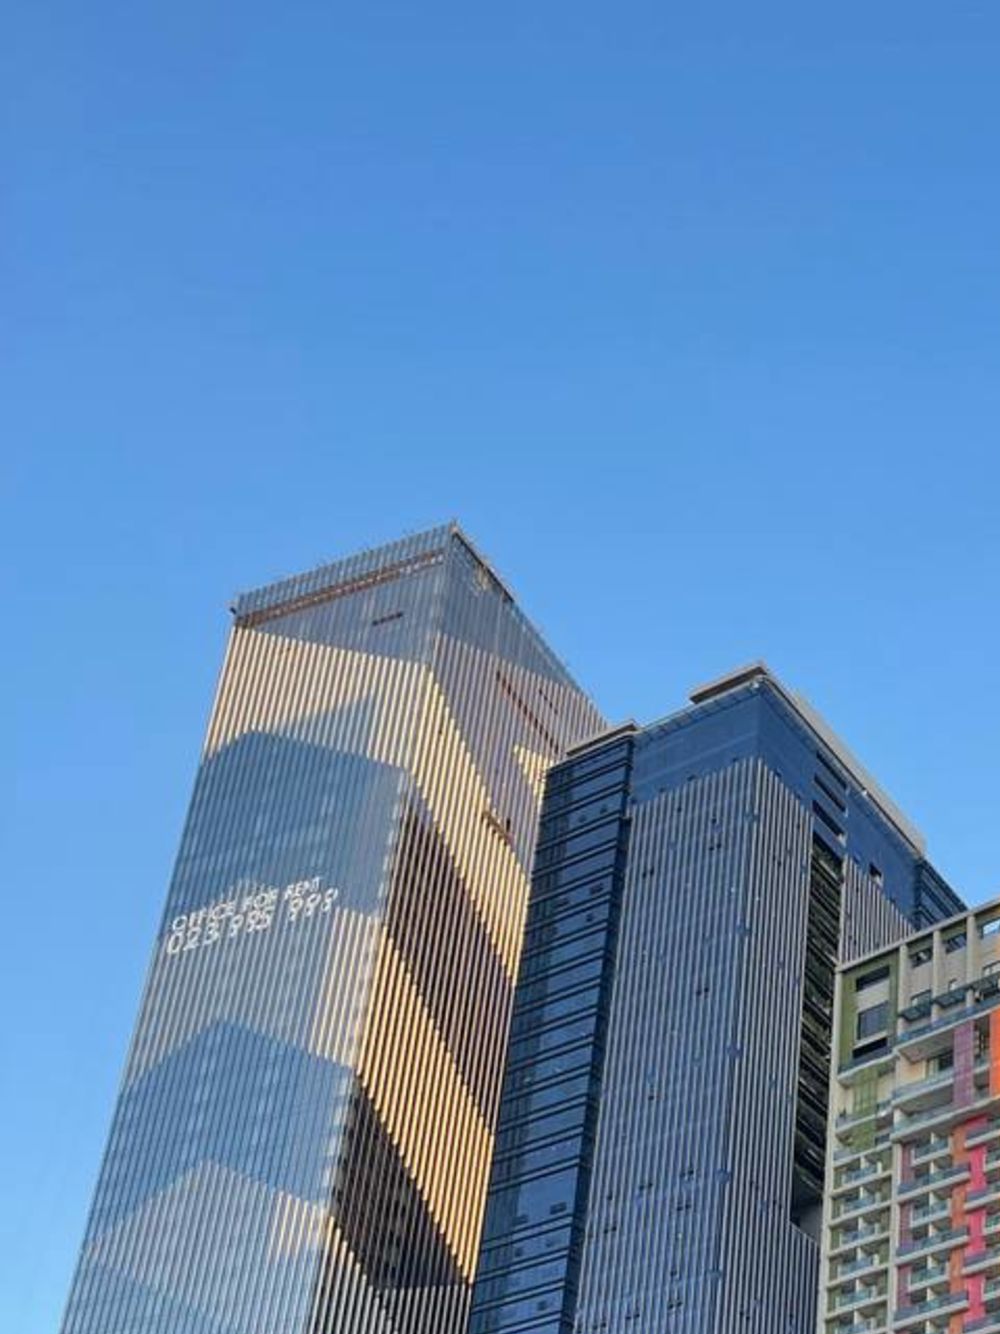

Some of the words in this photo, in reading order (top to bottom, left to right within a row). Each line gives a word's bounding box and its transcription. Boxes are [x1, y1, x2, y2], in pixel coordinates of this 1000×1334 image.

[172, 903, 235, 931] OFFICE
[243, 887, 279, 912] FOR
[284, 876, 321, 900] RENT
[166, 918, 221, 955] 023
